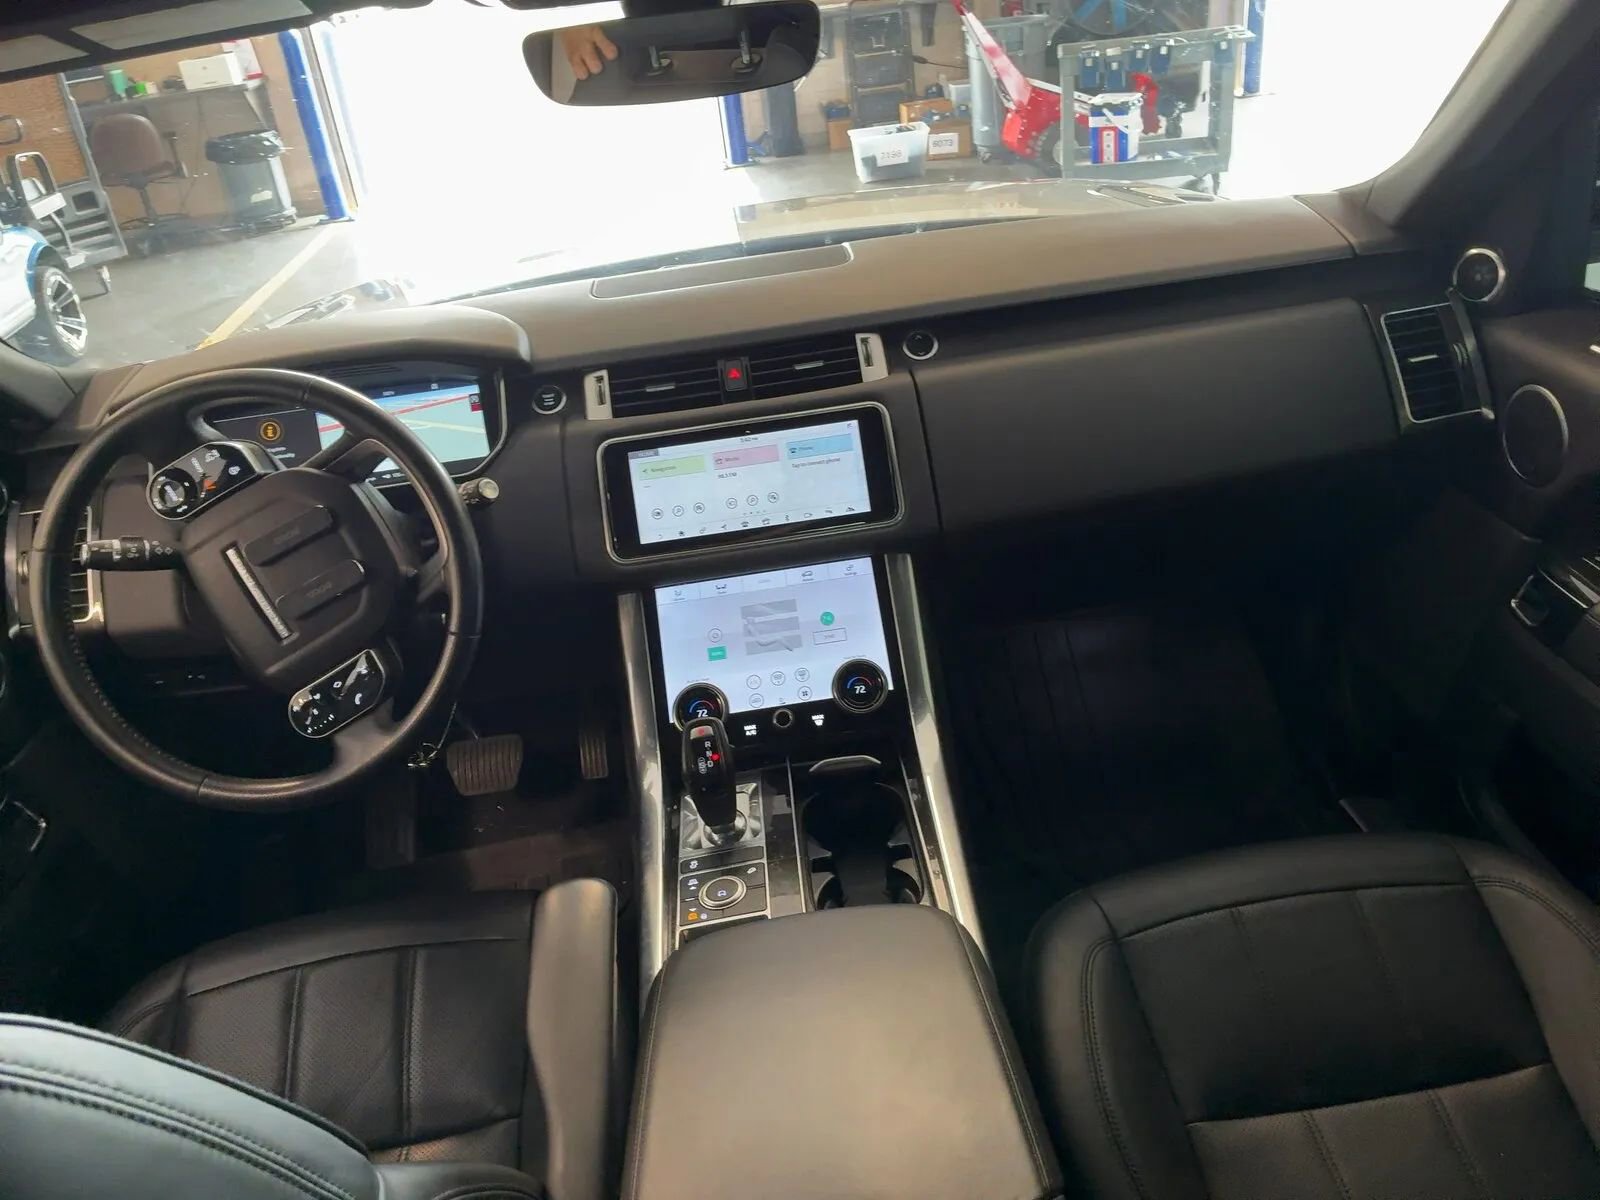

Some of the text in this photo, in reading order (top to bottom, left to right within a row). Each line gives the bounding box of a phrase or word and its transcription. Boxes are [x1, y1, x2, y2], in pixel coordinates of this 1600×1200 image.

[854, 685, 867, 694] 72
[696, 709, 709, 718] 72
[707, 760, 714, 768] D
